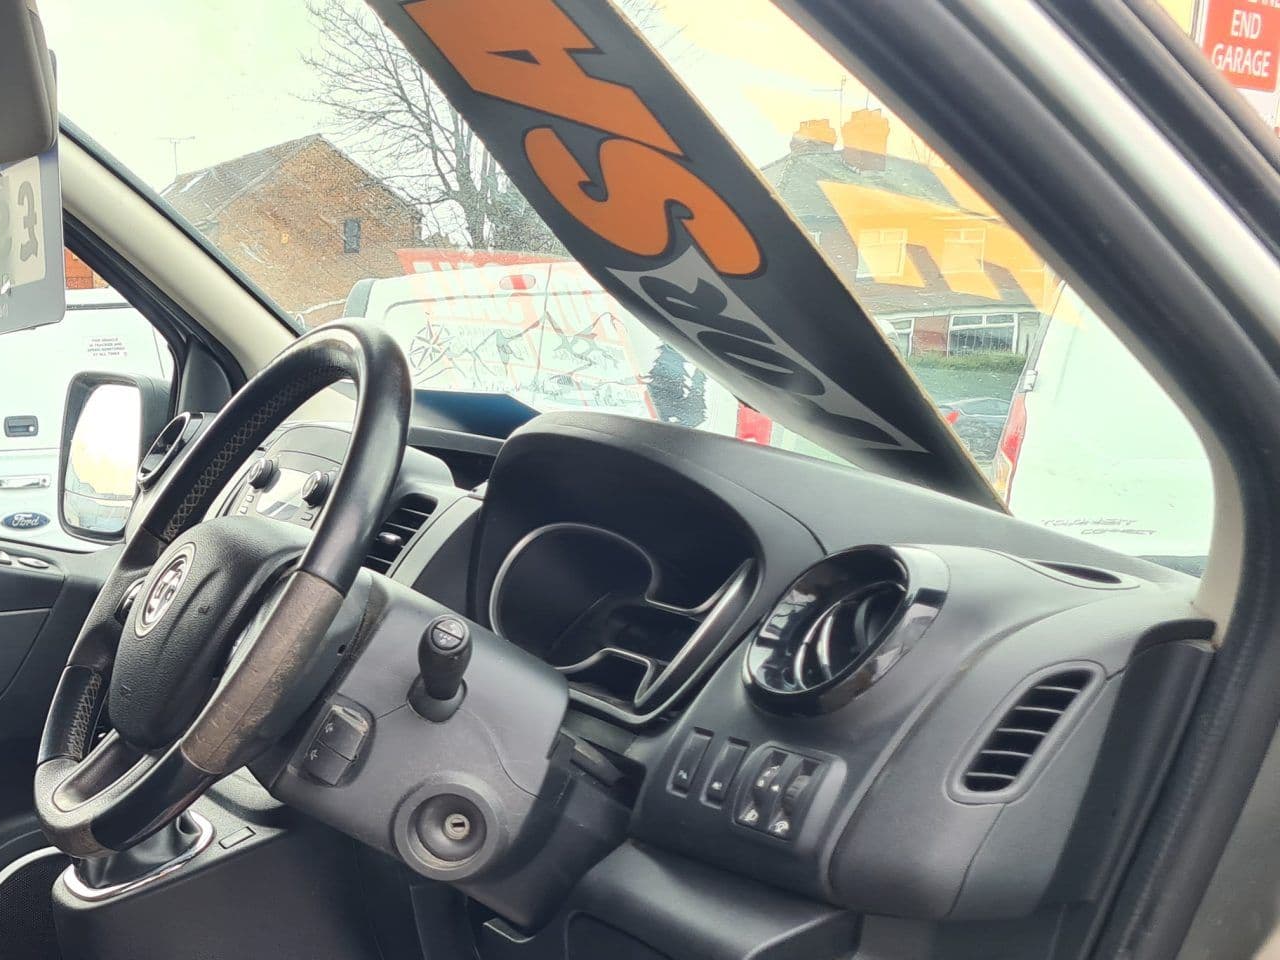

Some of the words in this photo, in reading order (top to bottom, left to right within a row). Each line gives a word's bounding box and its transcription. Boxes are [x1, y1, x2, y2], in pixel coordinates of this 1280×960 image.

[1230, 9, 1261, 40] END
[1211, 43, 1272, 77] GARAGE
[11, 513, 41, 527] Ford
